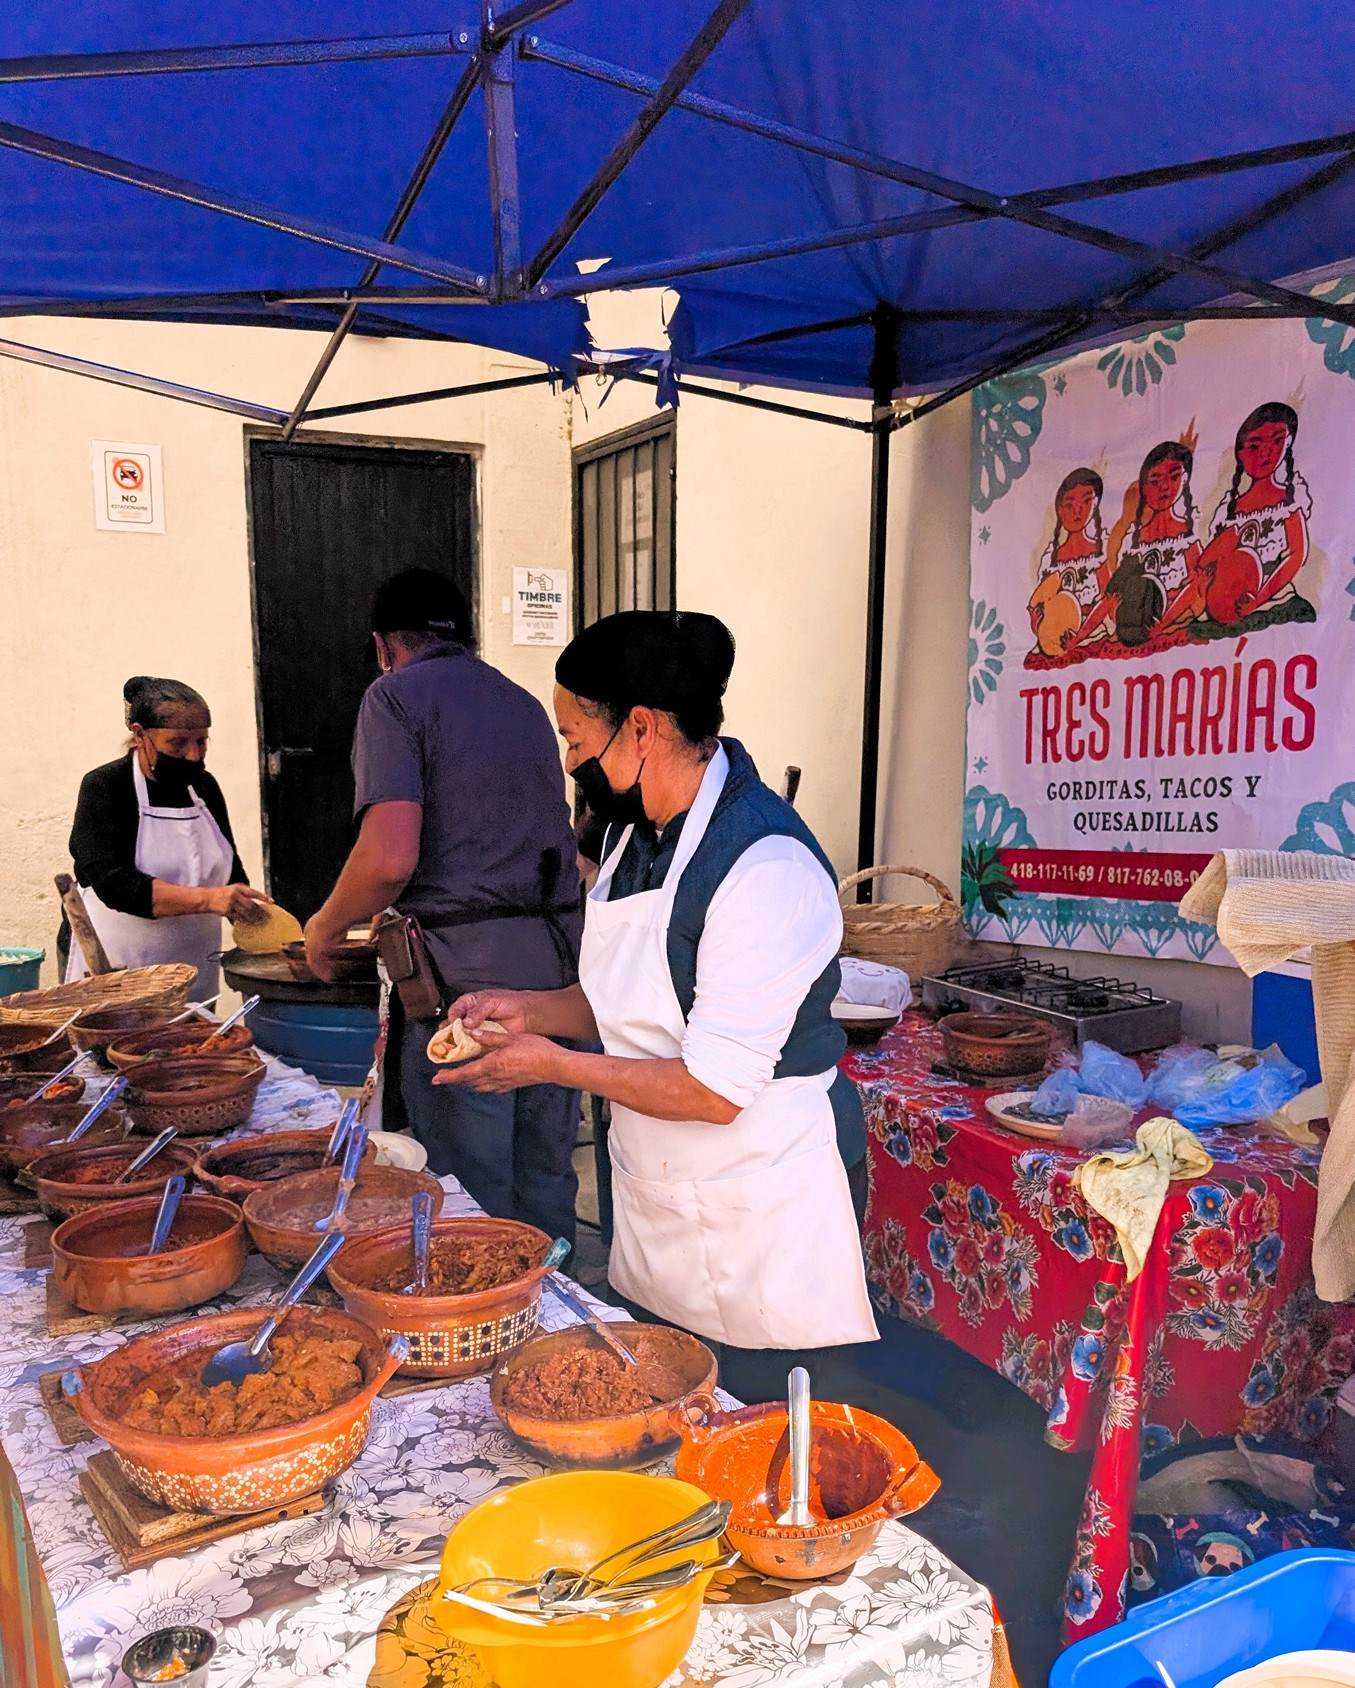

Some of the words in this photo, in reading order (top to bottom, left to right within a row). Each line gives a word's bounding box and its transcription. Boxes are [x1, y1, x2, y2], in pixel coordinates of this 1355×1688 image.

[121, 494, 138, 503] NO
[518, 591, 562, 603] TIMBRE
[1019, 678, 1111, 765] TRES
[1123, 636, 1318, 760] MARÍAS
[1047, 778, 1151, 802] GORDITAS,
[1160, 776, 1232, 799] TACOS
[1244, 775, 1262, 798] Y
[1073, 811, 1219, 835] QUESADILLAS
[1010, 862, 1095, 882] 418-117-11-69
[1097, 866, 1104, 883] /
[1107, 866, 1200, 888] 817-762-08-0
